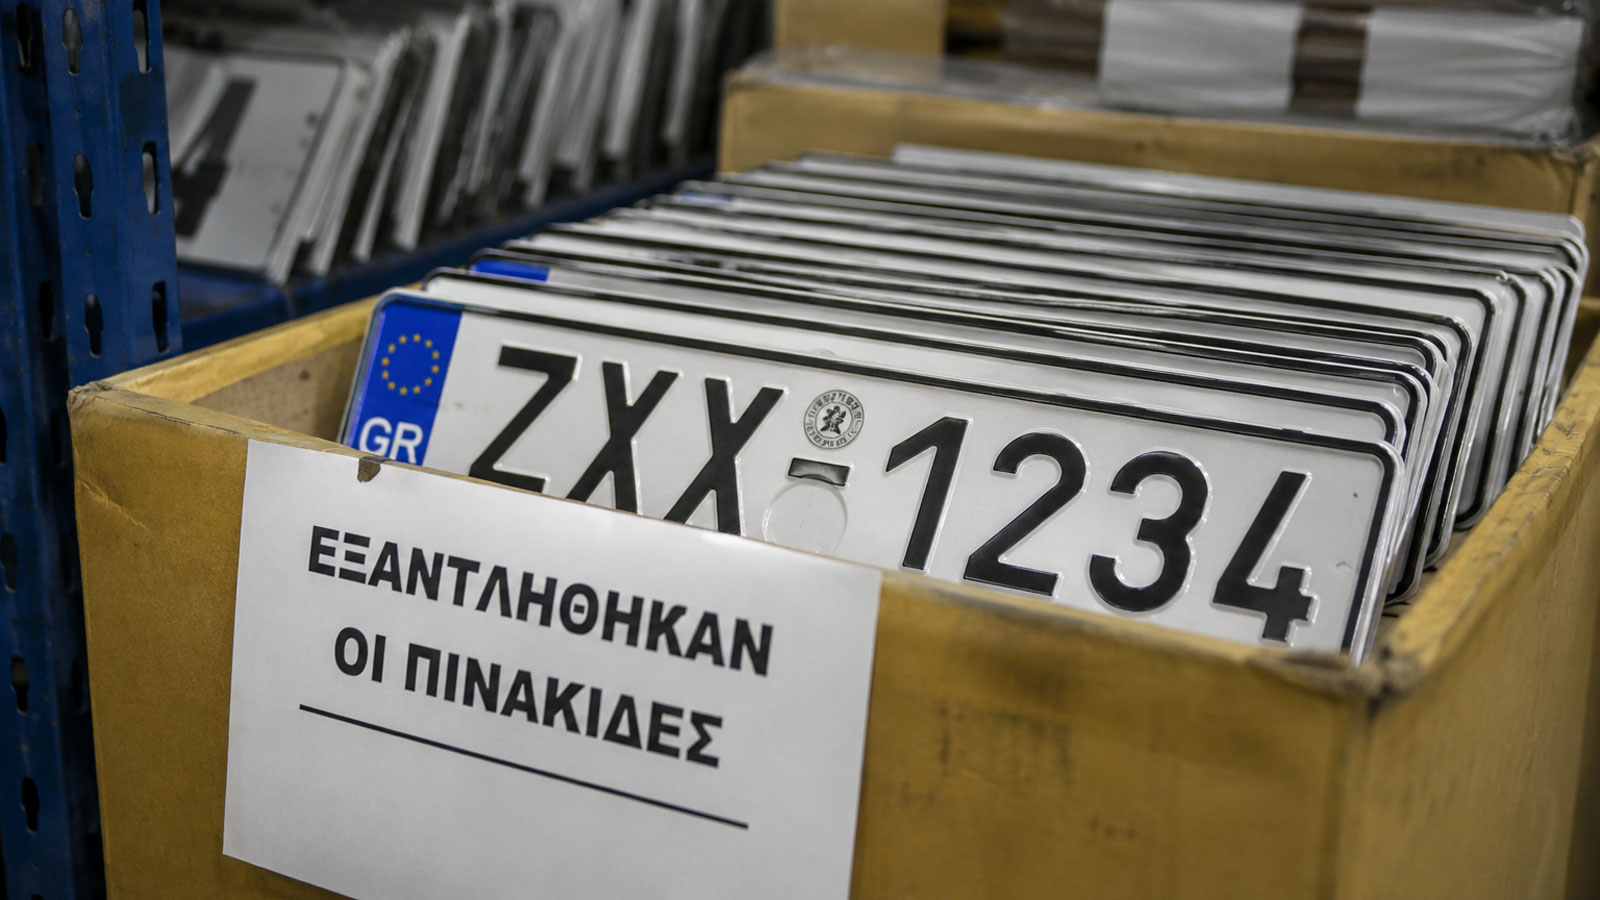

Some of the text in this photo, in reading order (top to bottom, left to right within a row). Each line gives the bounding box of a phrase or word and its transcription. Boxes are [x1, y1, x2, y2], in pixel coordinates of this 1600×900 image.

[359, 416, 424, 464] GR
[308, 525, 774, 677] ΕΞΑΝΤΛΗΘΗΚΑΝ
[335, 627, 723, 768] ΟΙ ΠΙΝΑΚΙΔΕΣ
